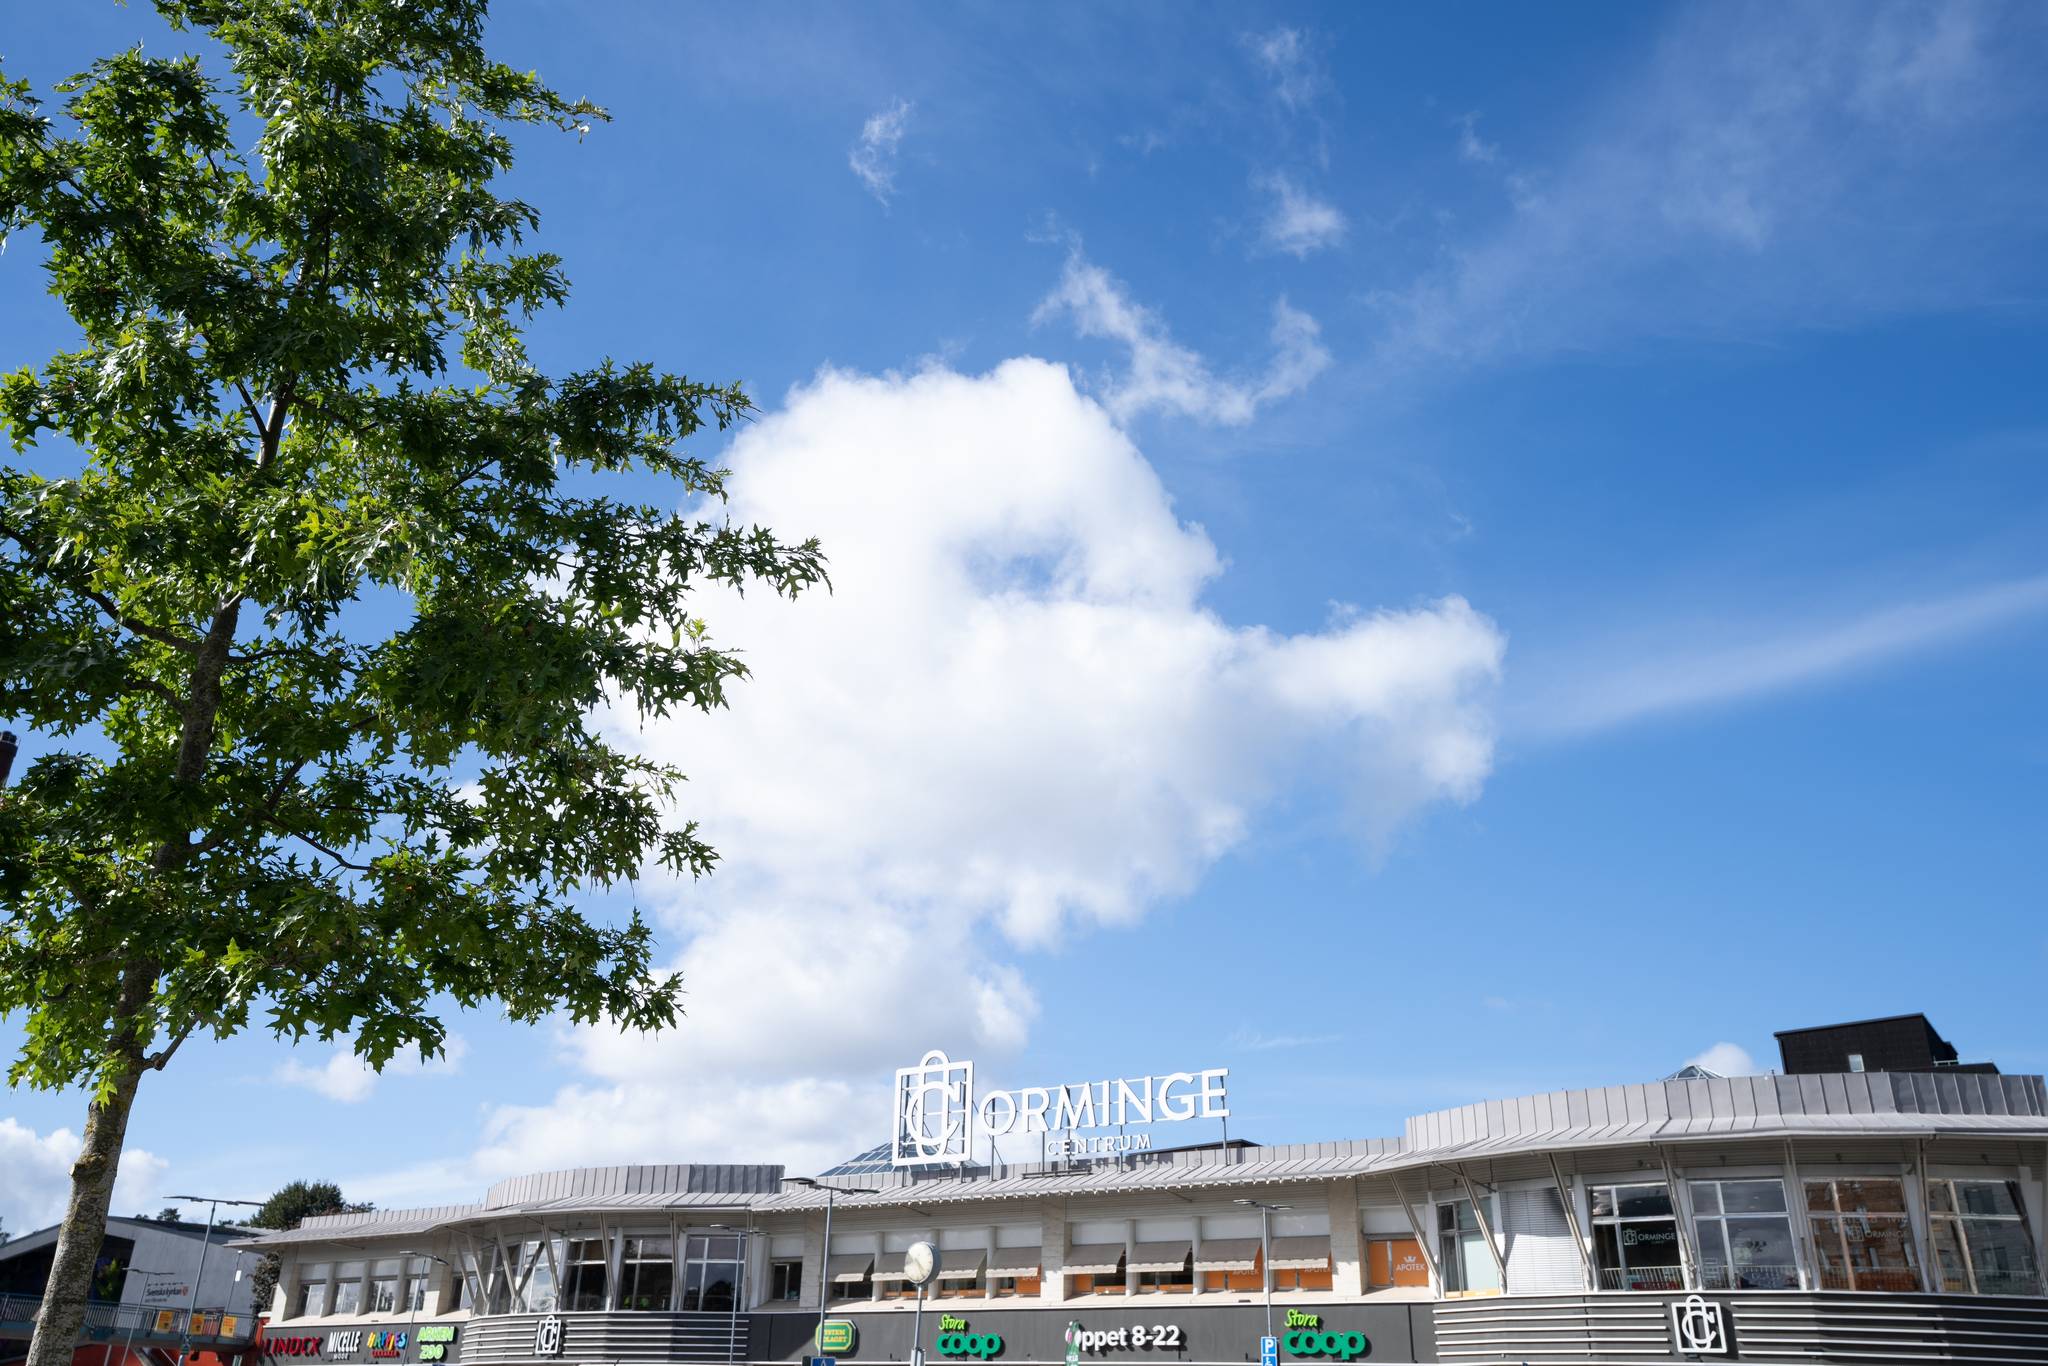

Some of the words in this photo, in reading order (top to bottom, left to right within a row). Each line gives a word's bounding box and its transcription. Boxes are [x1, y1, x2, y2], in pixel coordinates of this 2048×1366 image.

[978, 1068, 1231, 1137] ORMINGE
[1047, 1133, 1152, 1156] CENTRUM
[1396, 1263, 1425, 1272] APOTEK
[939, 1314, 966, 1331] Stora
[1284, 1309, 1318, 1328] Stora
[327, 1331, 361, 1352] MICELLE
[1131, 1325, 1180, 1346] 8-22
[1283, 1331, 1366, 1360] coop
[419, 1344, 445, 1360] ZOO
[937, 1334, 1001, 1360] coop
[1265, 1339, 1274, 1354] P
